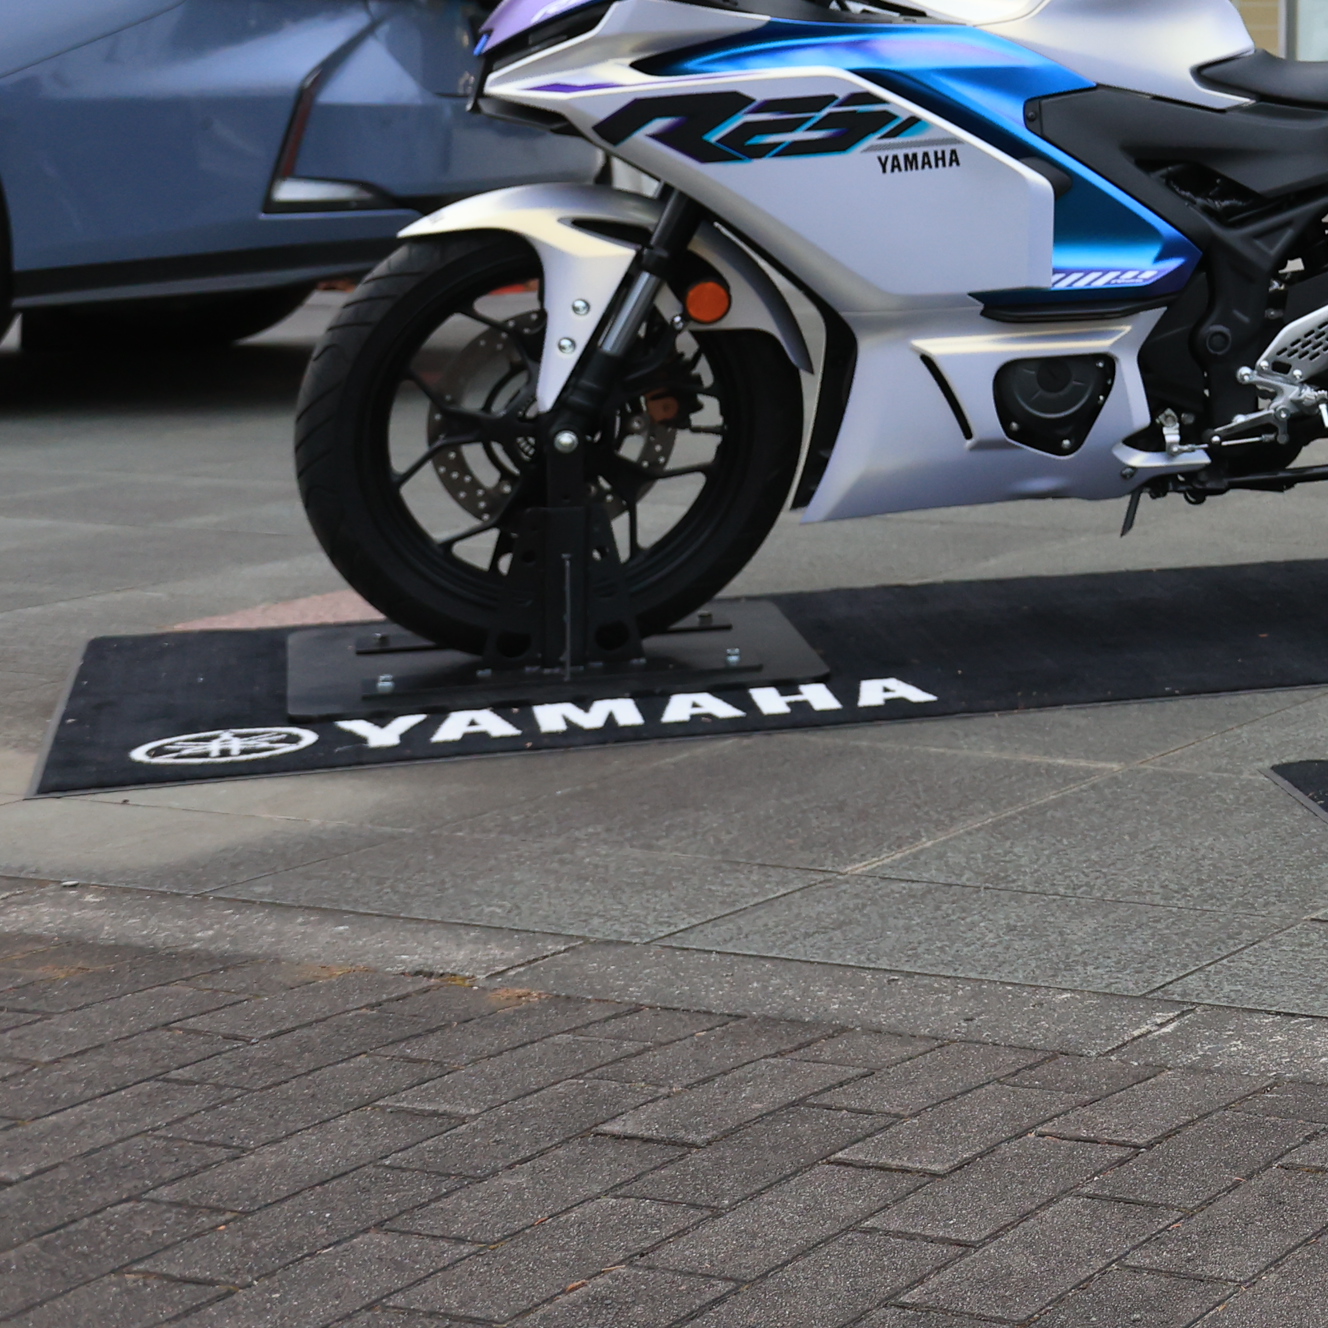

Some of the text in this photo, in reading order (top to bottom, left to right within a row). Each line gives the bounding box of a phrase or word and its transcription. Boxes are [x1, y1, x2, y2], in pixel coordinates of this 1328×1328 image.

[592, 90, 904, 165] R25
[877, 148, 961, 174] YAMAHA
[335, 676, 938, 749] YAMAHA
